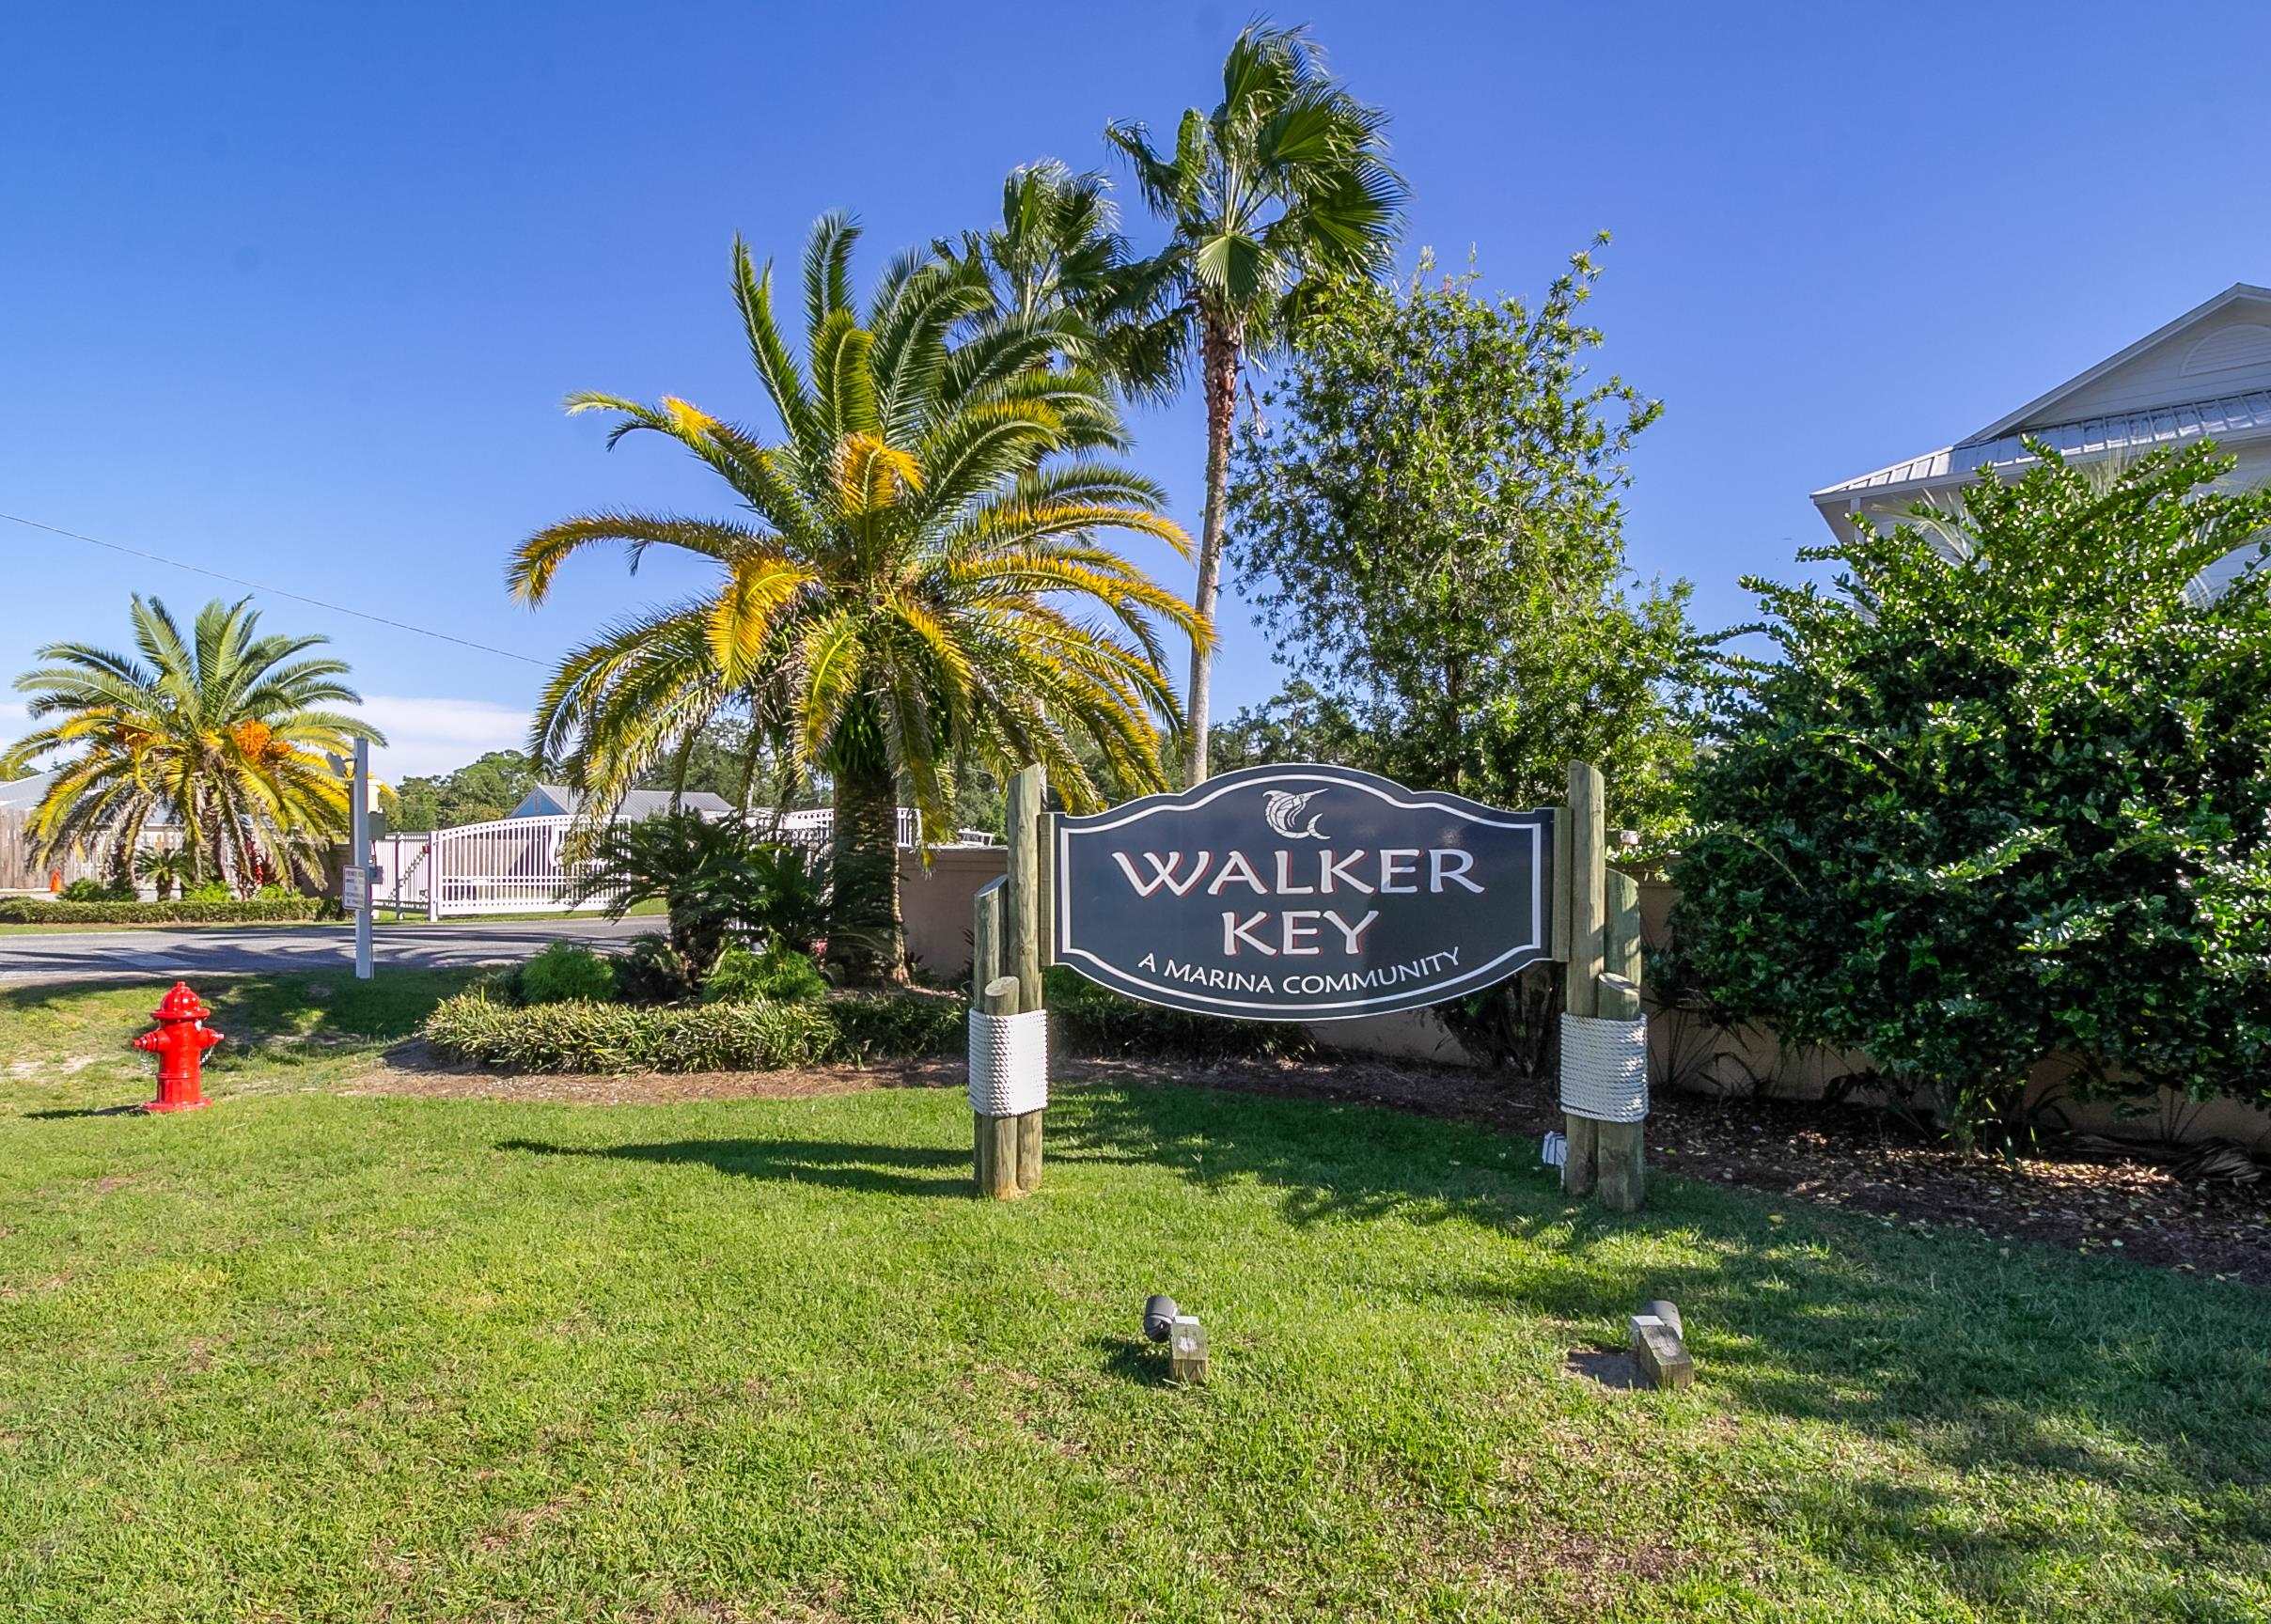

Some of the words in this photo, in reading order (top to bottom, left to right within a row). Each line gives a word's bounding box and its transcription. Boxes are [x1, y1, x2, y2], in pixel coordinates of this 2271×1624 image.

[1111, 849, 1486, 897] WALKER
[1221, 910, 1380, 957] KEY
[1137, 952, 1157, 974] A
[1164, 959, 1275, 994] MARINA
[1282, 945, 1460, 995] COMMUNITY
